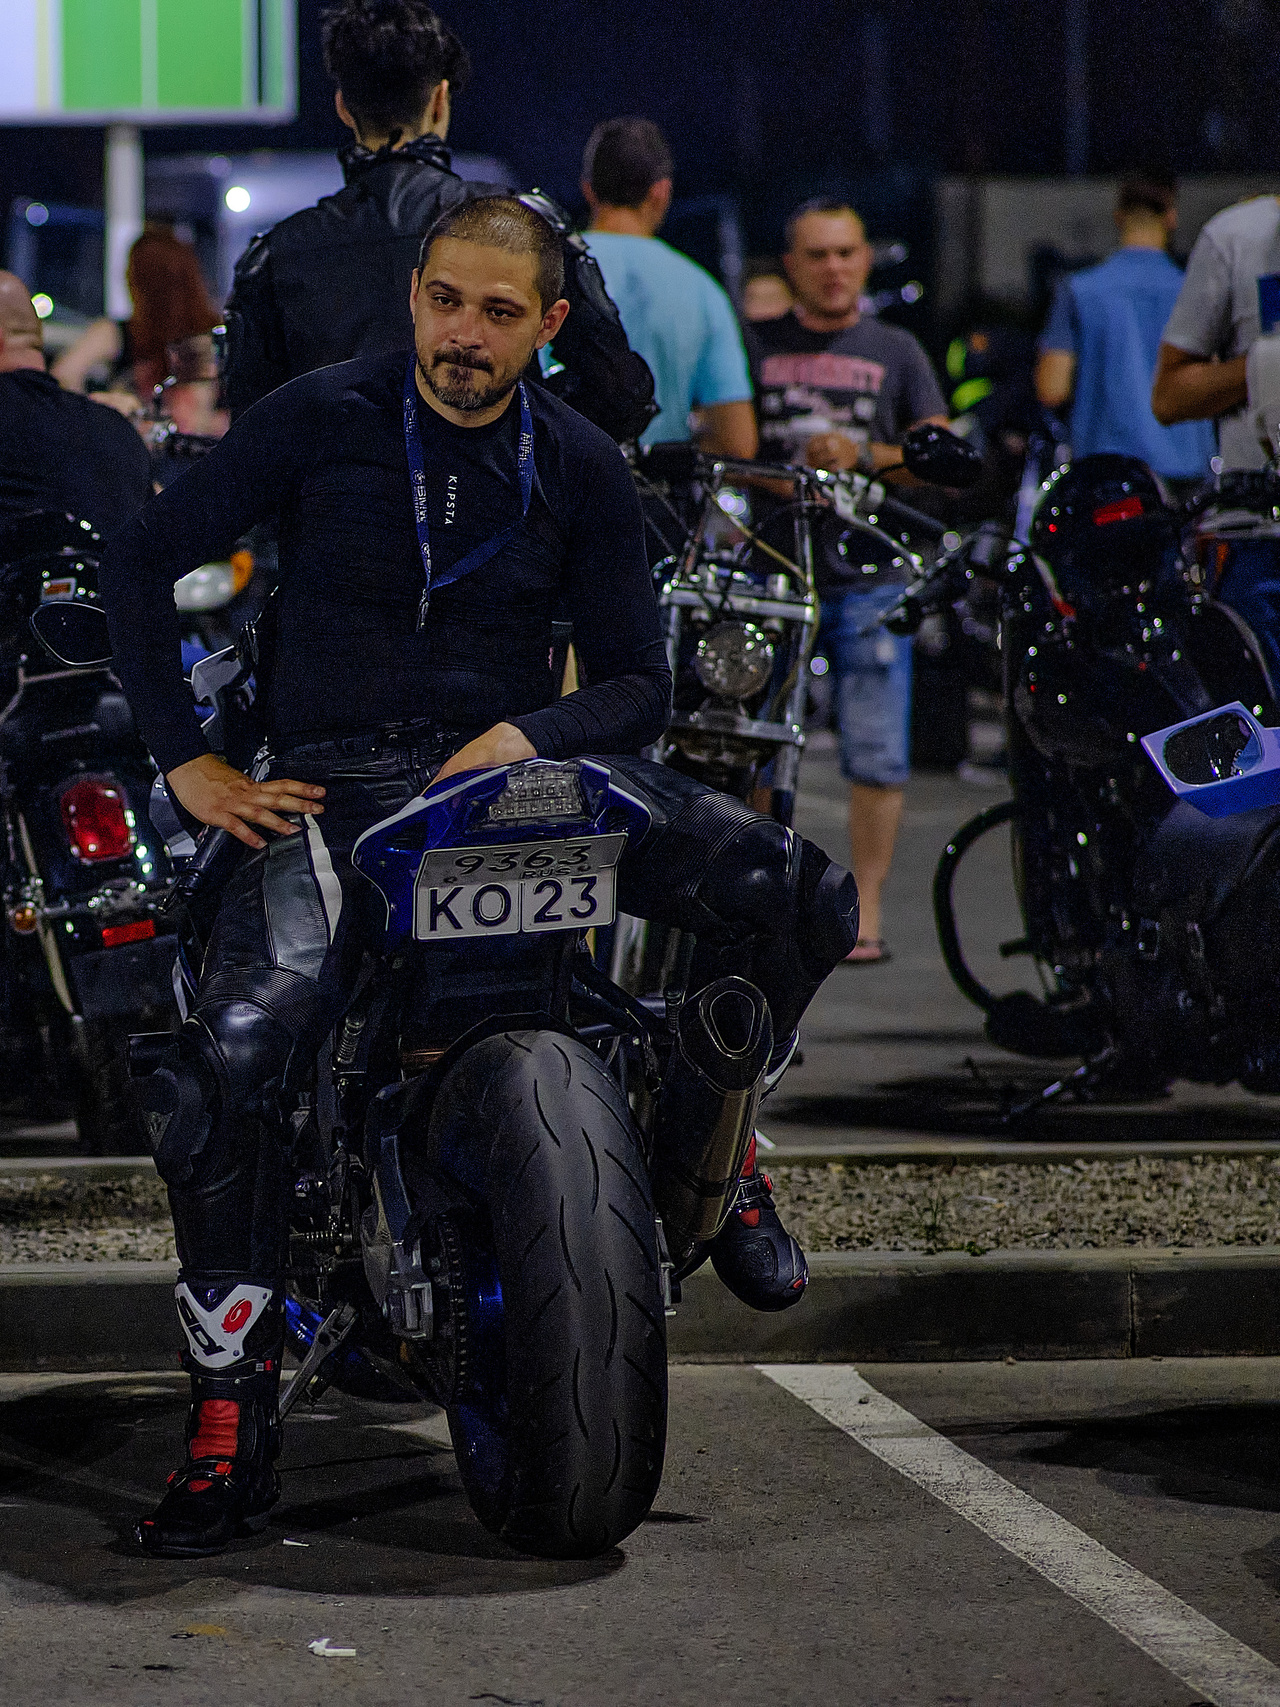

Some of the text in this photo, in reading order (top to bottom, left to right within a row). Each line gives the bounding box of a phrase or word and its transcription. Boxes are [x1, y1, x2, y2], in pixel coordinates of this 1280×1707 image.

[444, 475, 458, 525] KIPSTA
[455, 844, 593, 875] 9363
[522, 866, 571, 879] RUS
[429, 874, 598, 932] KO 23
